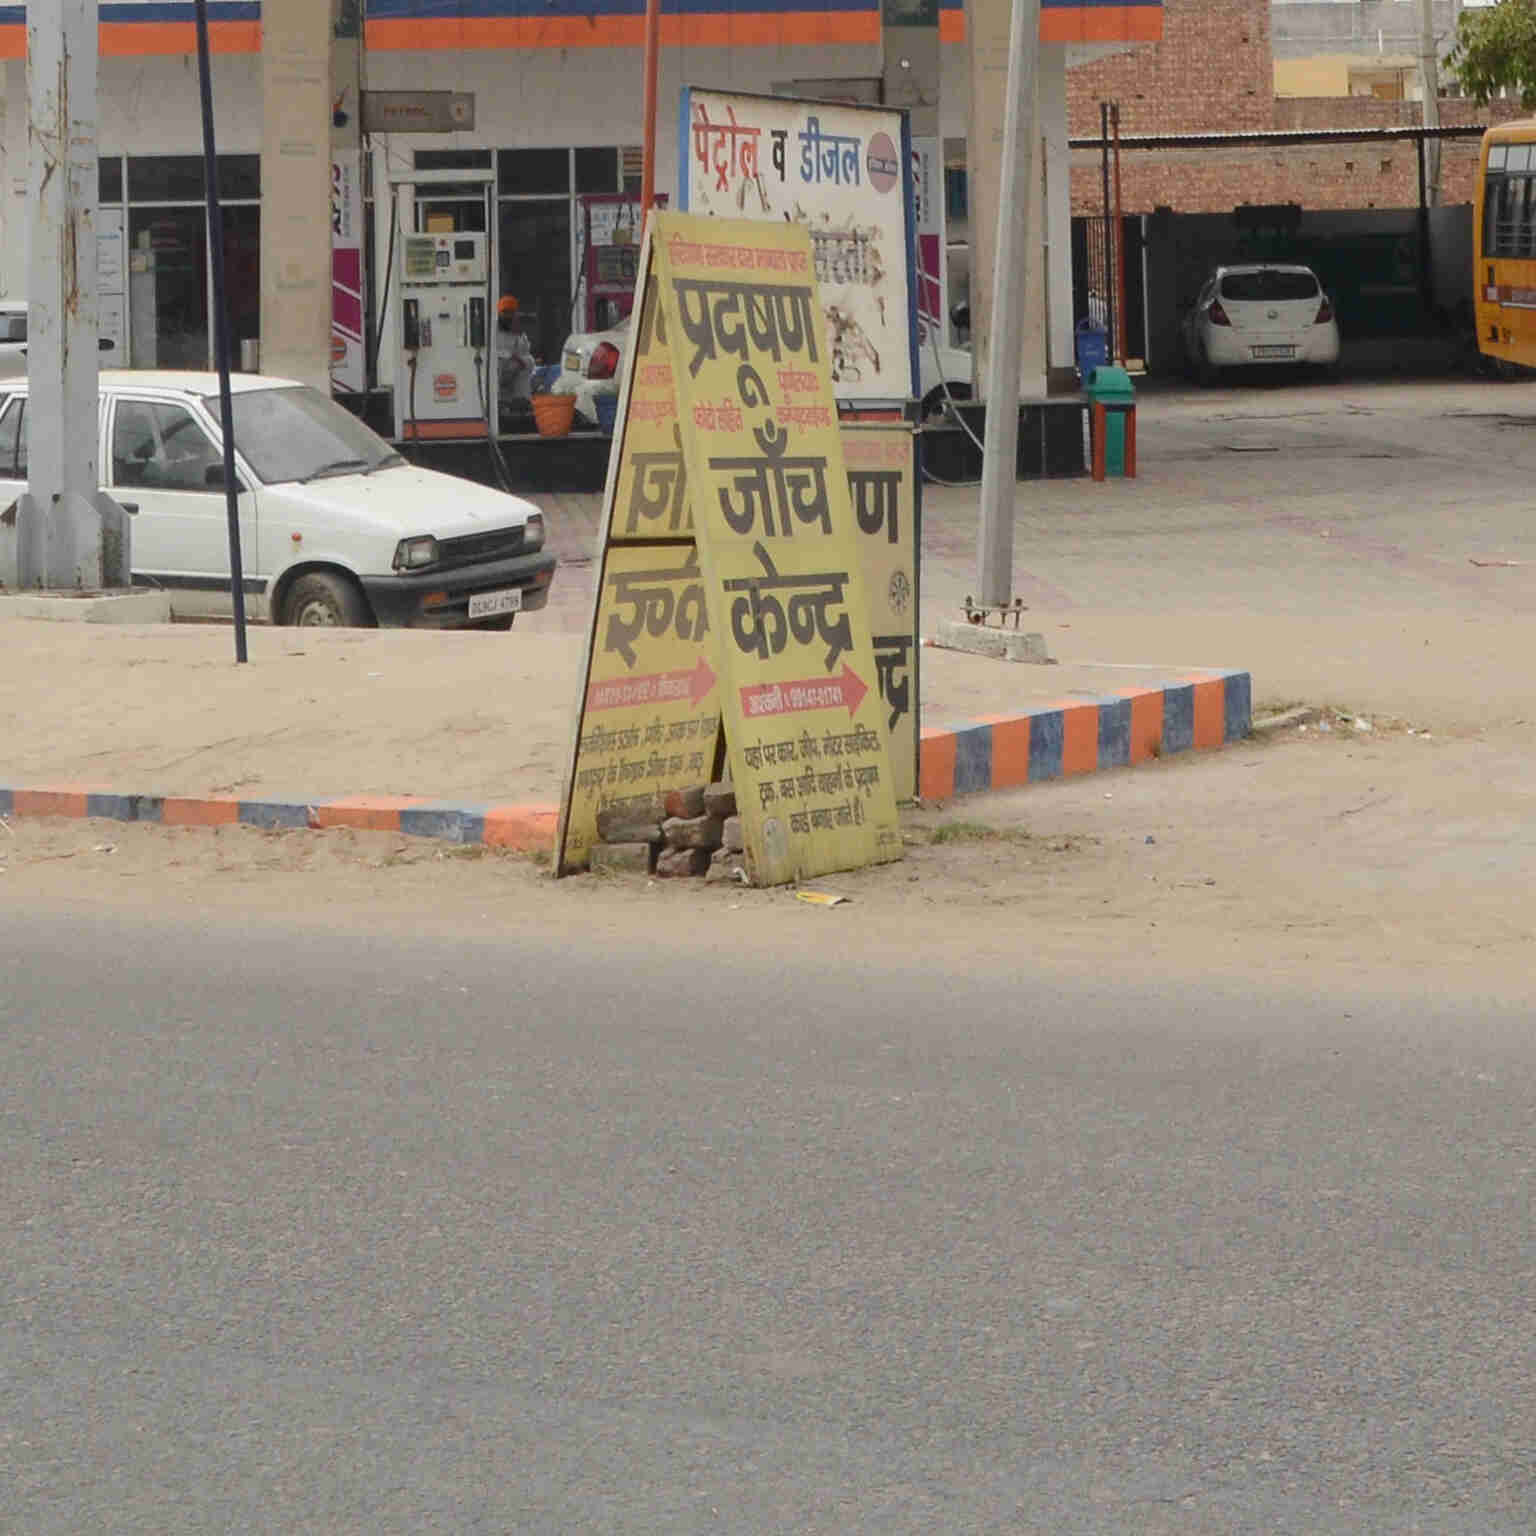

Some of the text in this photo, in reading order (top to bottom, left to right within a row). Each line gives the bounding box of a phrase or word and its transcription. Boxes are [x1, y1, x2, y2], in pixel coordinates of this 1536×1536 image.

[770, 129, 788, 183] व
[798, 116, 861, 186] डीजल
[672, 277, 820, 407] प्रदूषण
[709, 418, 833, 538] जाँच
[721, 540, 855, 672] केन्द्र
